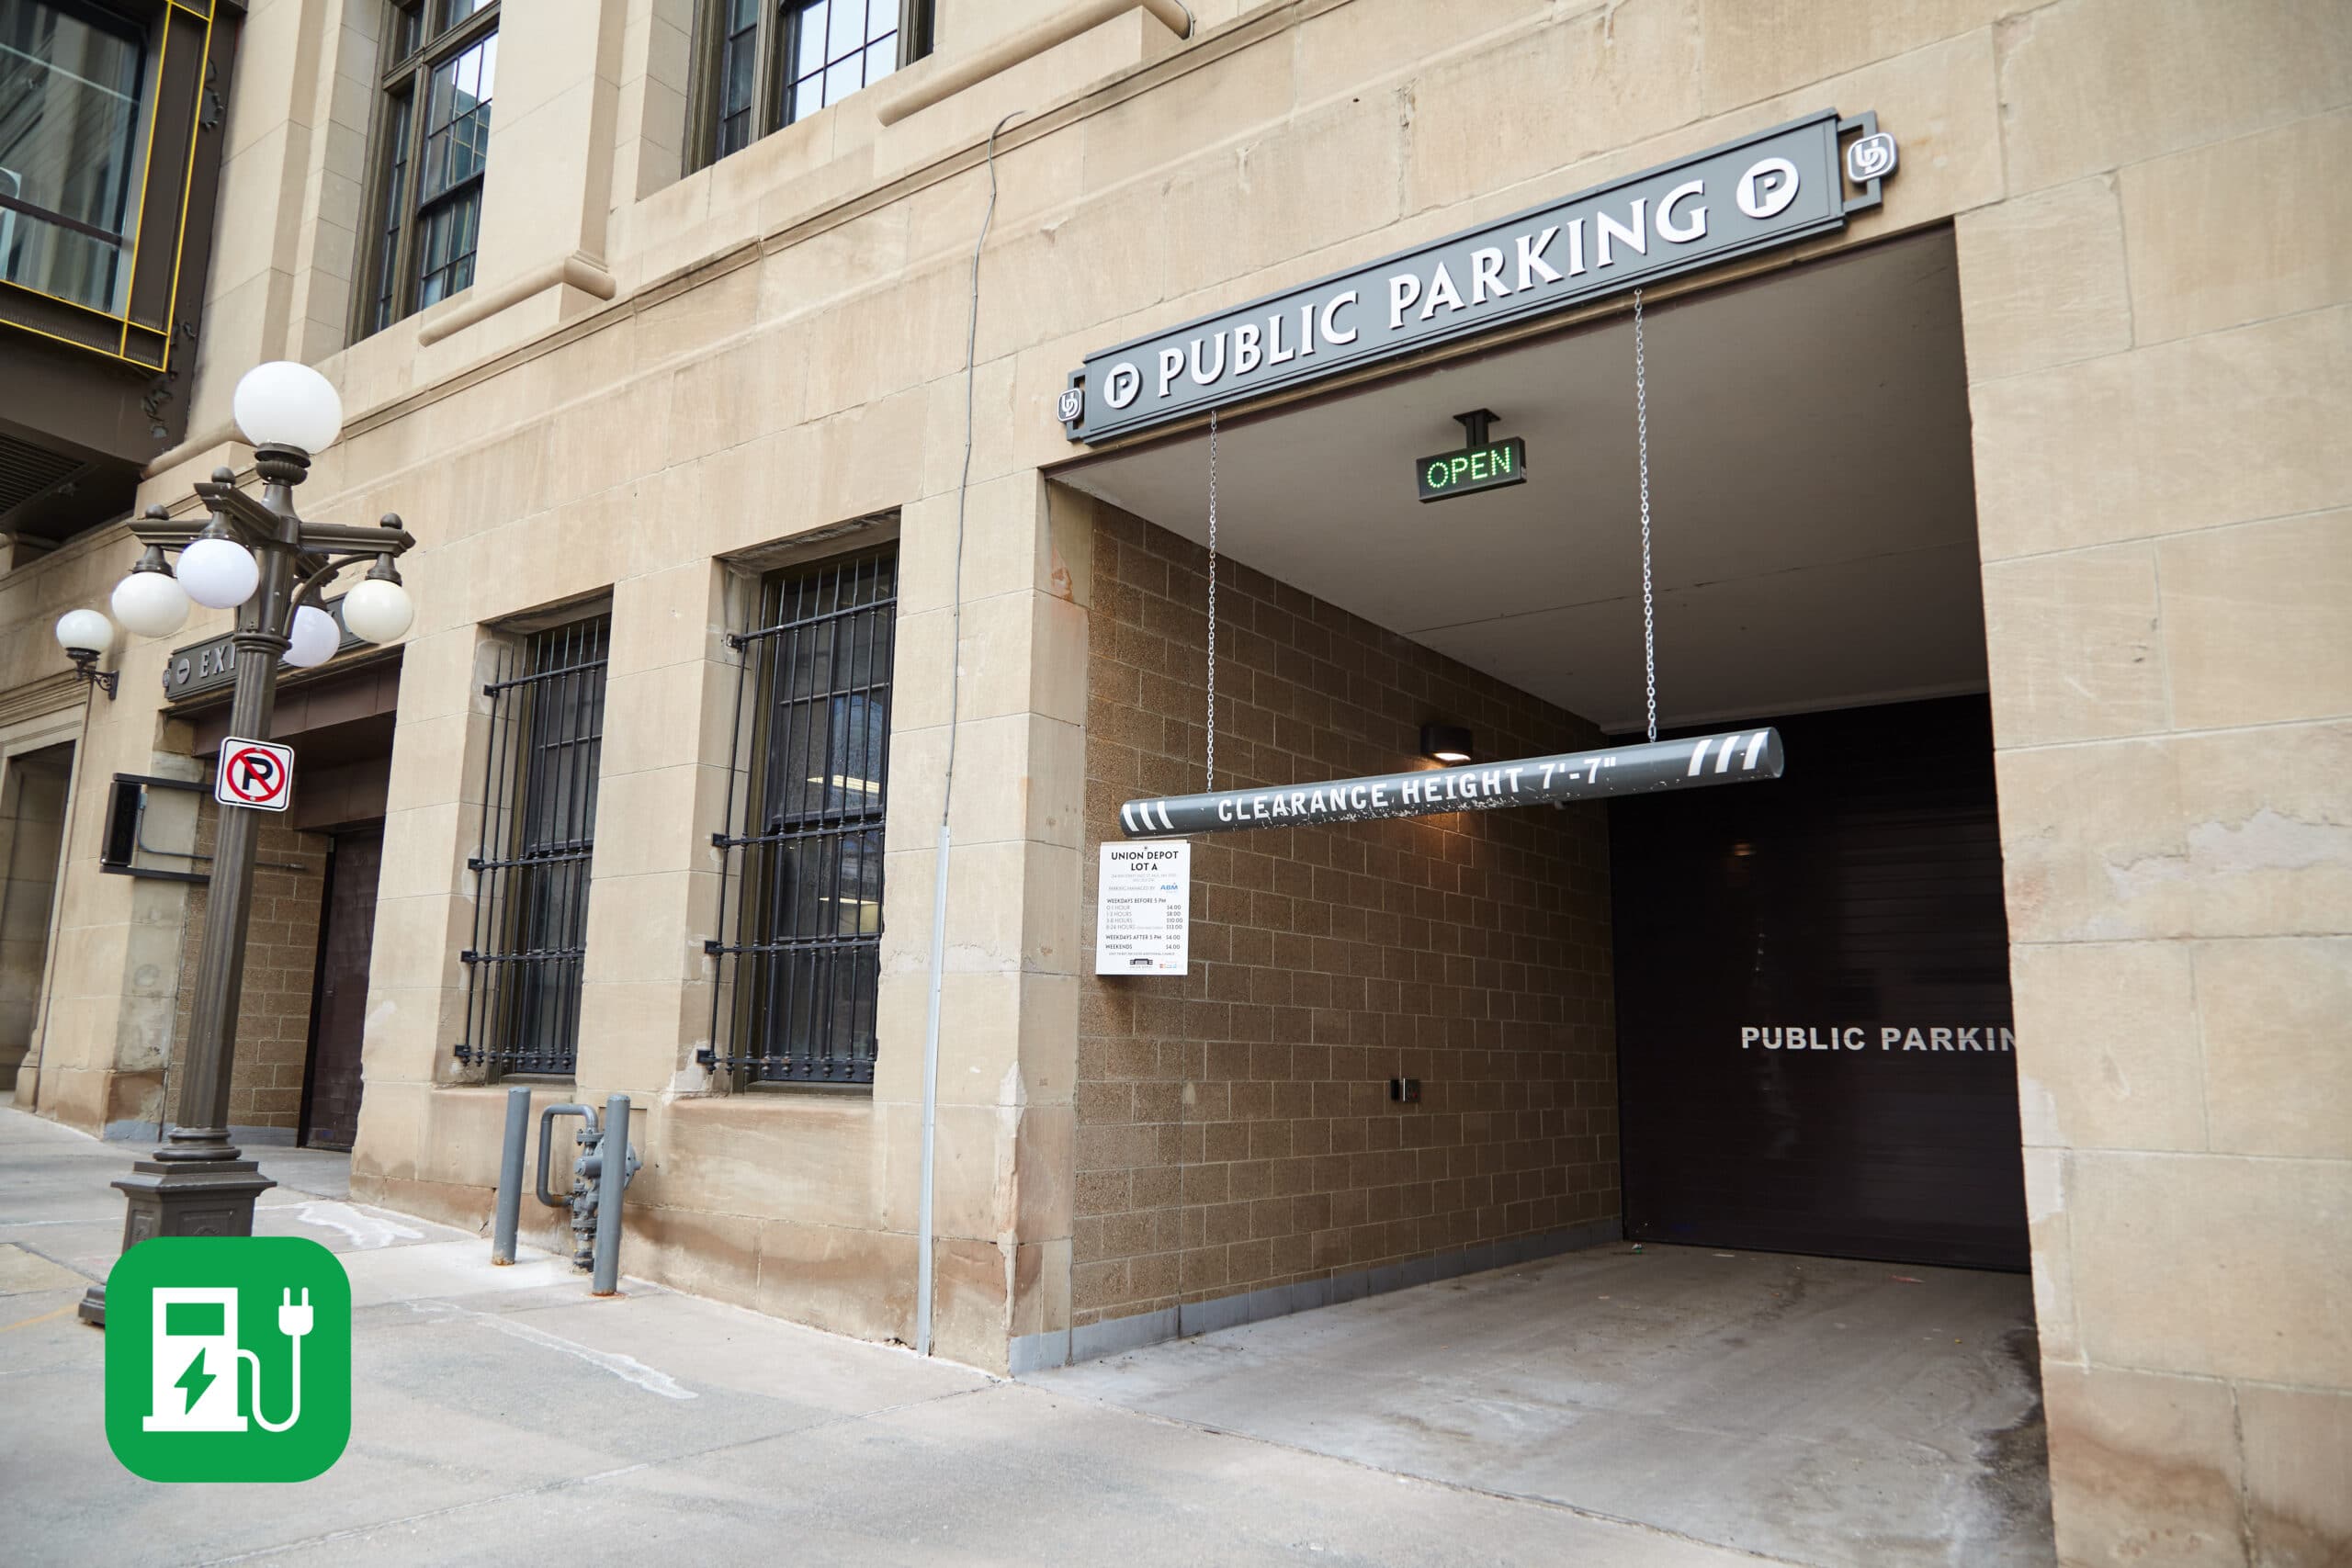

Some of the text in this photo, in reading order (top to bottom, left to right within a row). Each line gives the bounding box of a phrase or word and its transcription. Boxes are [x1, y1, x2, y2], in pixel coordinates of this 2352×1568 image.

[1158, 289, 1358, 398] PUBLIC
[1389, 179, 1709, 330] PARKING
[1427, 446, 1511, 488] OPEN
[199, 642, 236, 678] EXI
[1217, 784, 1388, 822] CLEARANCE
[1402, 767, 1523, 805] HEIGHT
[1111, 851, 1179, 861] UNION DEPOT
[1131, 863, 1158, 871] LOT A
[1741, 1027, 2017, 1051] PUBLIC PARKIN
